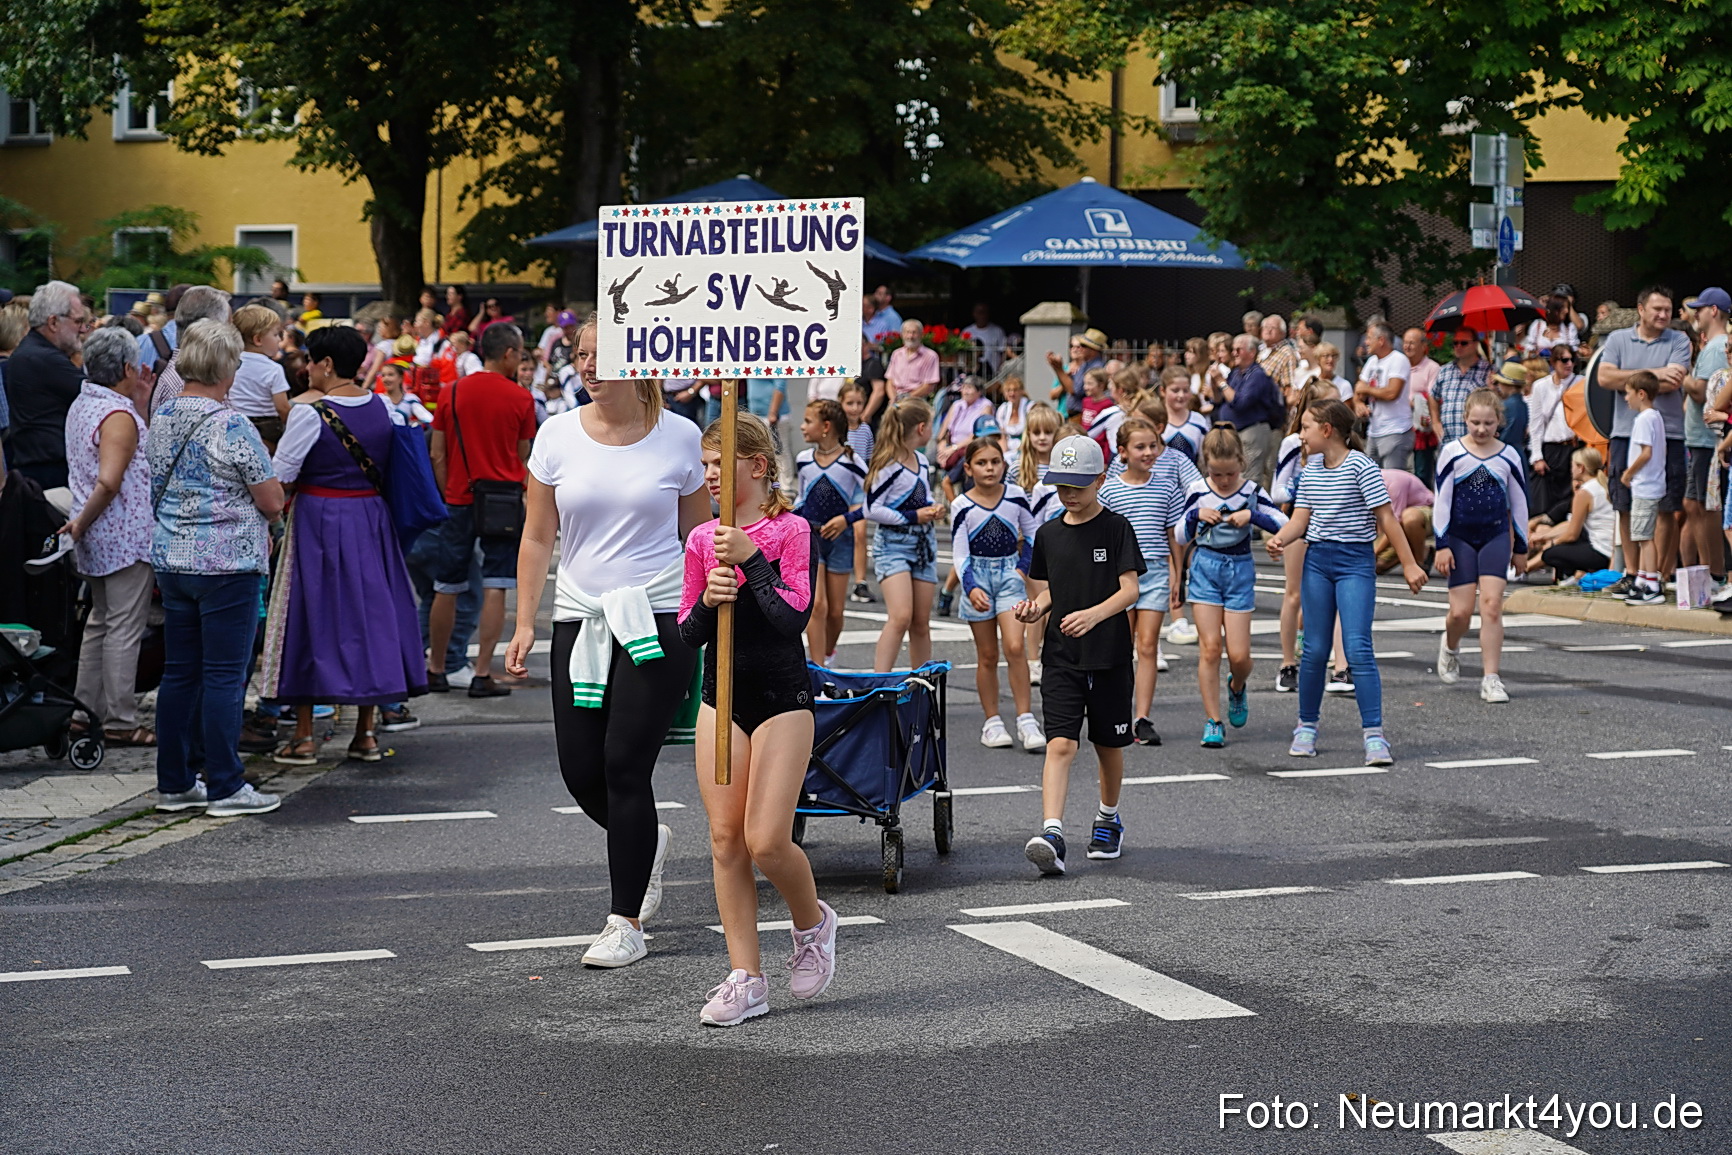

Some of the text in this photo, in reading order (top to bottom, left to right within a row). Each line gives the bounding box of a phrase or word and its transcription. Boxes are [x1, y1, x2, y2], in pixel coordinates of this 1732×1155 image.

[603, 214, 859, 257] TURNABTEILUNG
[706, 272, 752, 311] SV
[626, 316, 828, 363] HÖHENBERG
